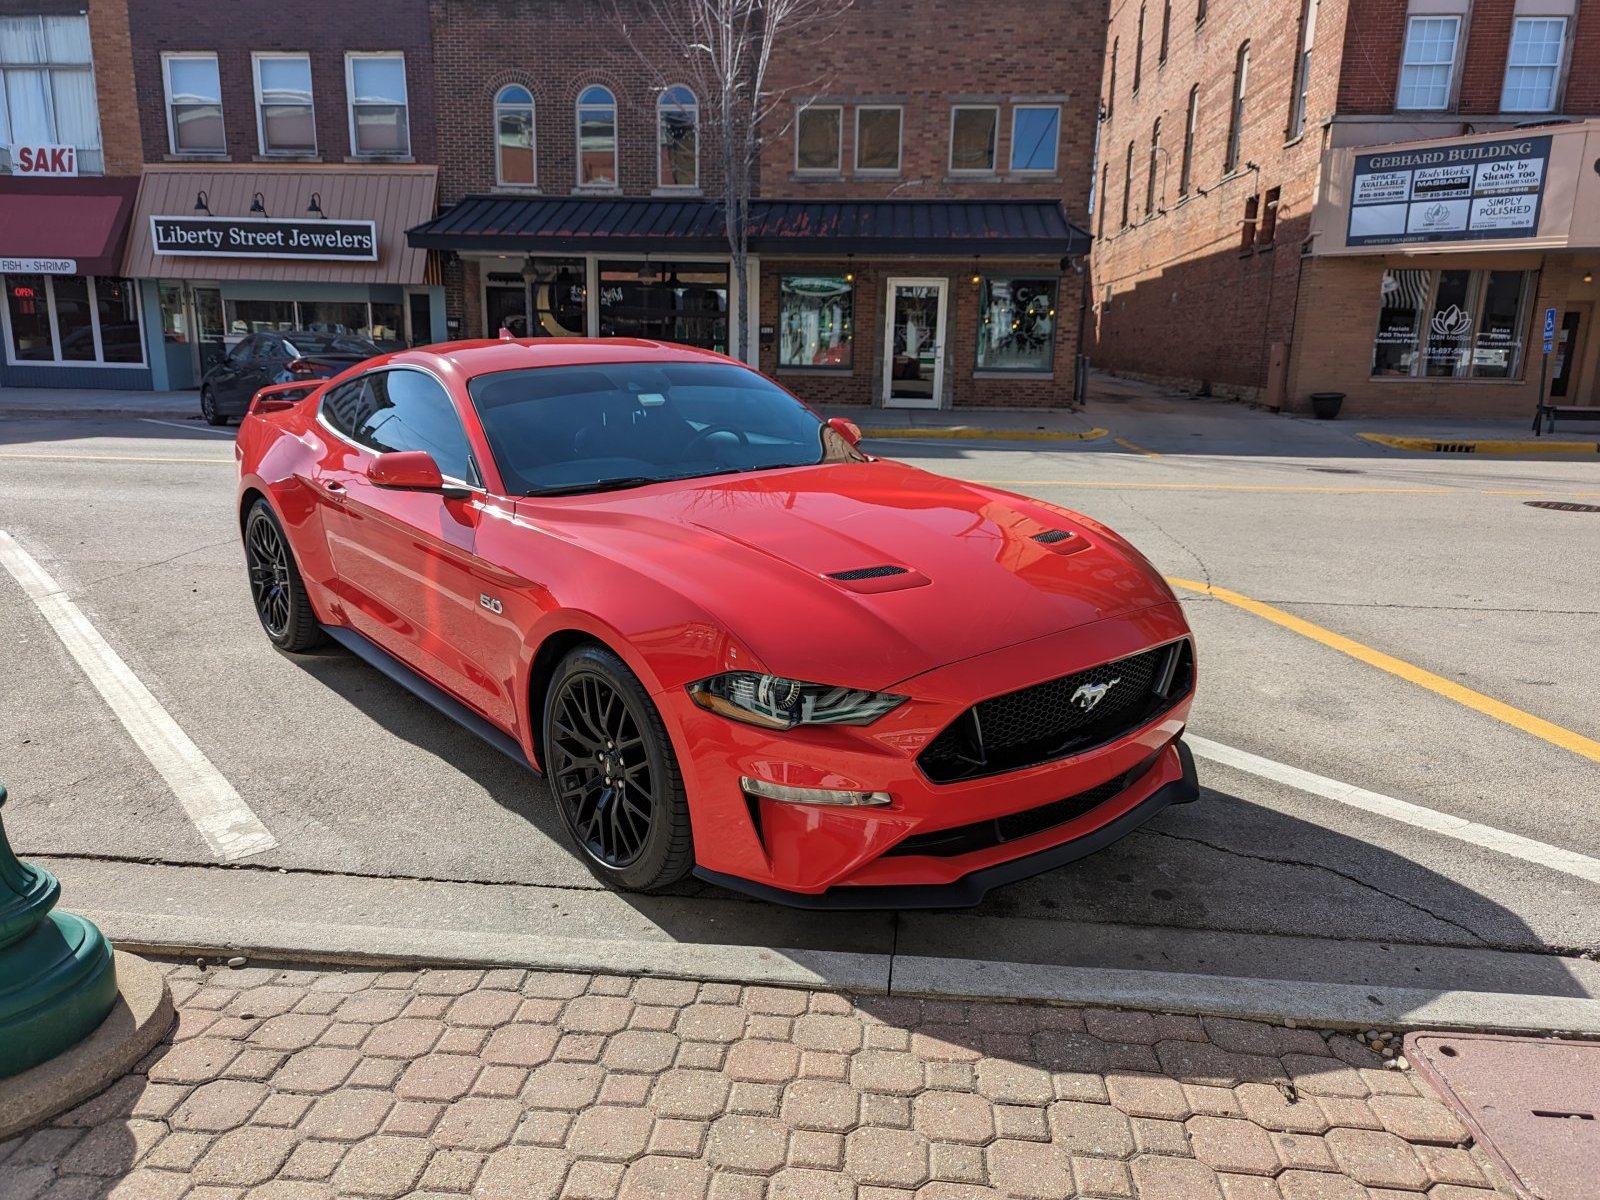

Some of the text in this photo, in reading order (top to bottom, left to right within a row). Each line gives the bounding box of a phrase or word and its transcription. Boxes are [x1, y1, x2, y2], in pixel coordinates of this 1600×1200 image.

[1369, 143, 1532, 169] GEBHARD BUILDING
[1491, 161, 1529, 172] Only by
[1370, 173, 1397, 181] SPACE
[1360, 179, 1406, 188] AVAILABLE
[1417, 178, 1468, 187] MASSAGE
[1488, 197, 1523, 207] SIMPLY
[1480, 205, 1531, 216] POLISHED
[156, 226, 372, 248] Liberty Street Jewelers
[2, 261, 71, 272] FISH SHRIMP
[15, 287, 34, 297] OPEN
